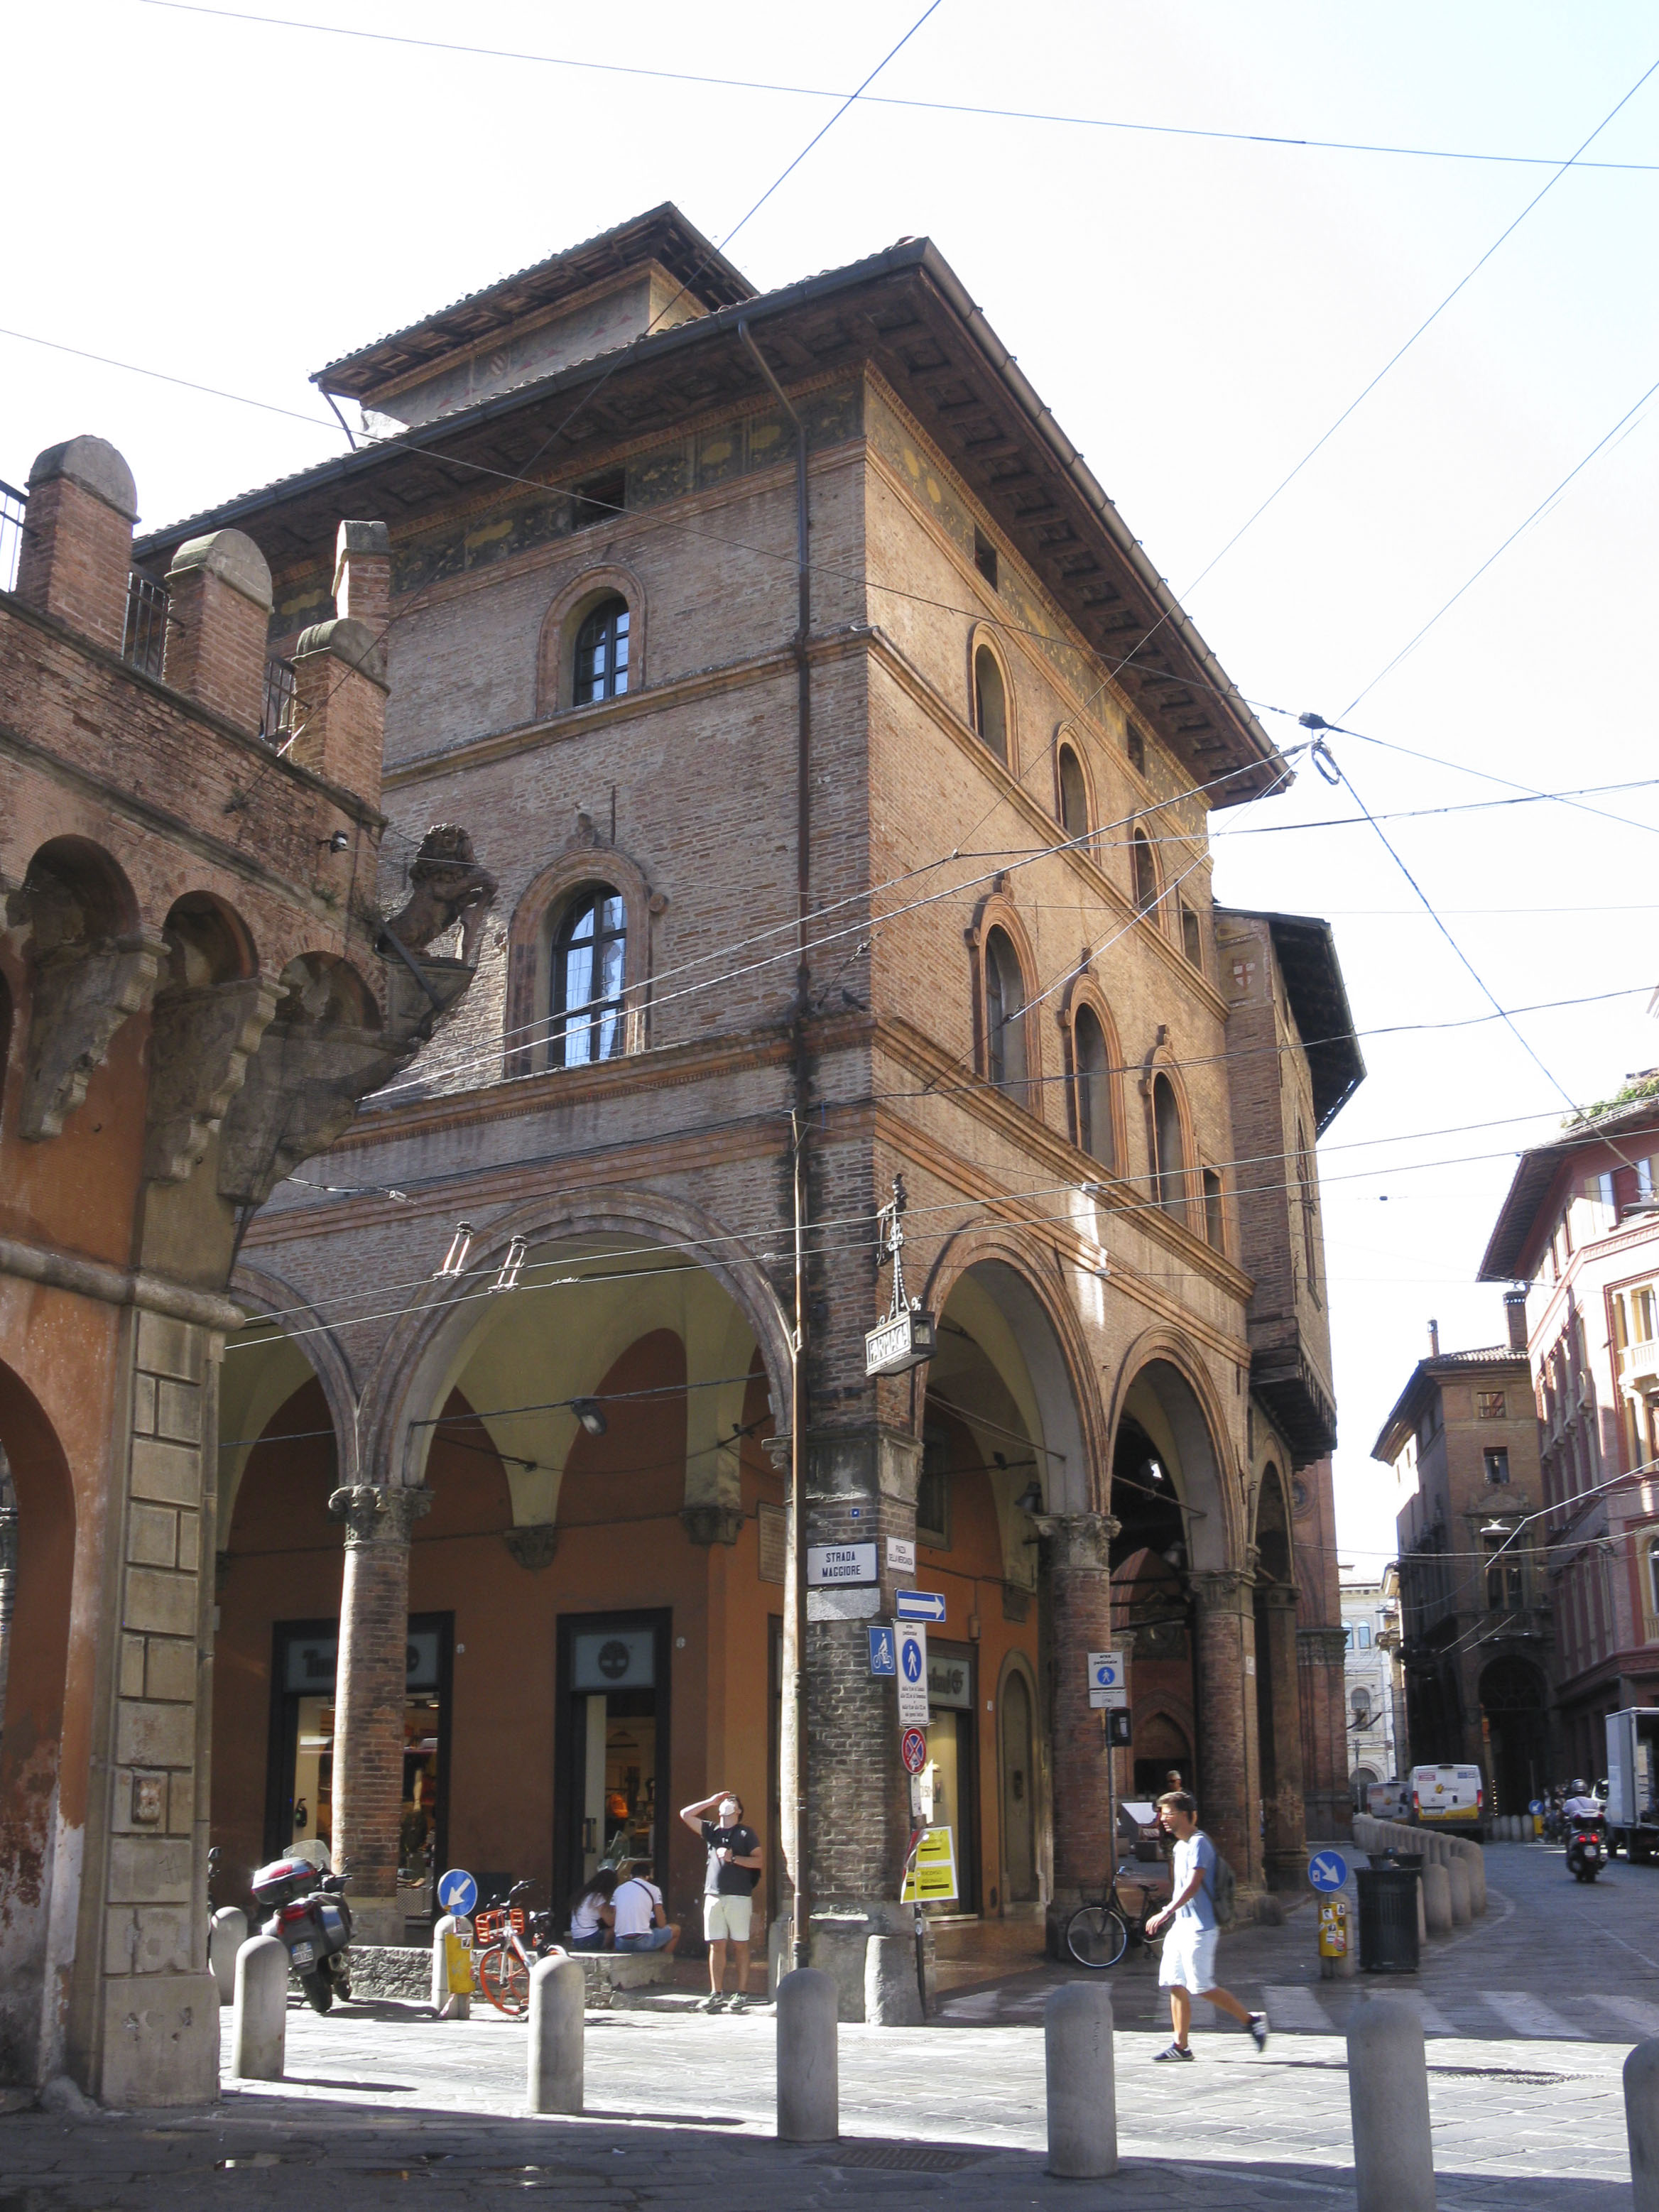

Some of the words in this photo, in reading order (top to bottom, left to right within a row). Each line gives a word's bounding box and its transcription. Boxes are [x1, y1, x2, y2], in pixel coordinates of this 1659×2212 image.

[869, 1322, 908, 1363] FARMACIA
[825, 1551, 856, 1563] STRADA
[822, 1564, 861, 1578] MAGGIORE
